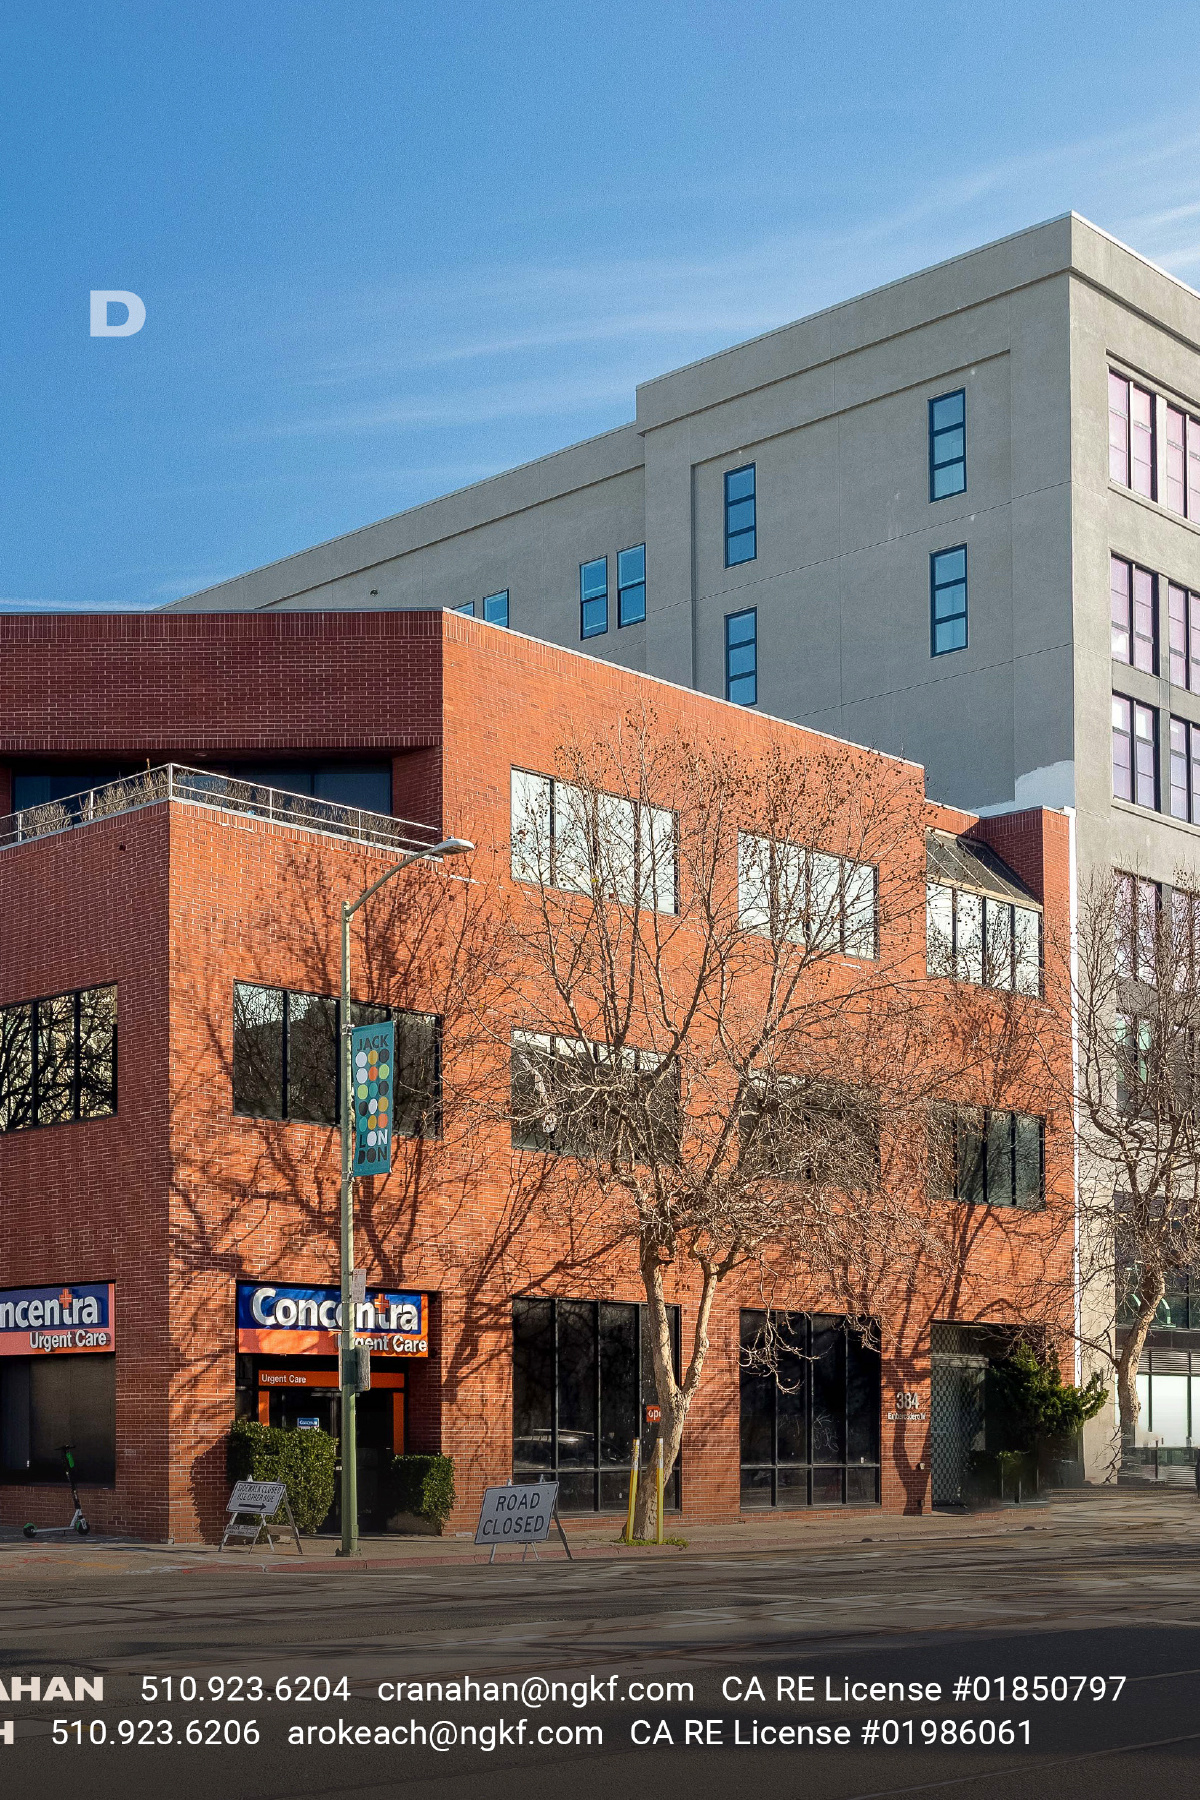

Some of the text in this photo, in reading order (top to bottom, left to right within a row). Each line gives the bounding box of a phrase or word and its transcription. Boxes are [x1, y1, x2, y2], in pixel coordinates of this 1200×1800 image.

[357, 1034, 389, 1051] JACK
[30, 1330, 107, 1352] Urgent Care
[392, 1335, 428, 1353] Care
[261, 1374, 307, 1384] Urgent Care
[896, 1391, 920, 1410] 384
[495, 1492, 541, 1512] ROAD
[482, 1515, 545, 1536] CLOSED
